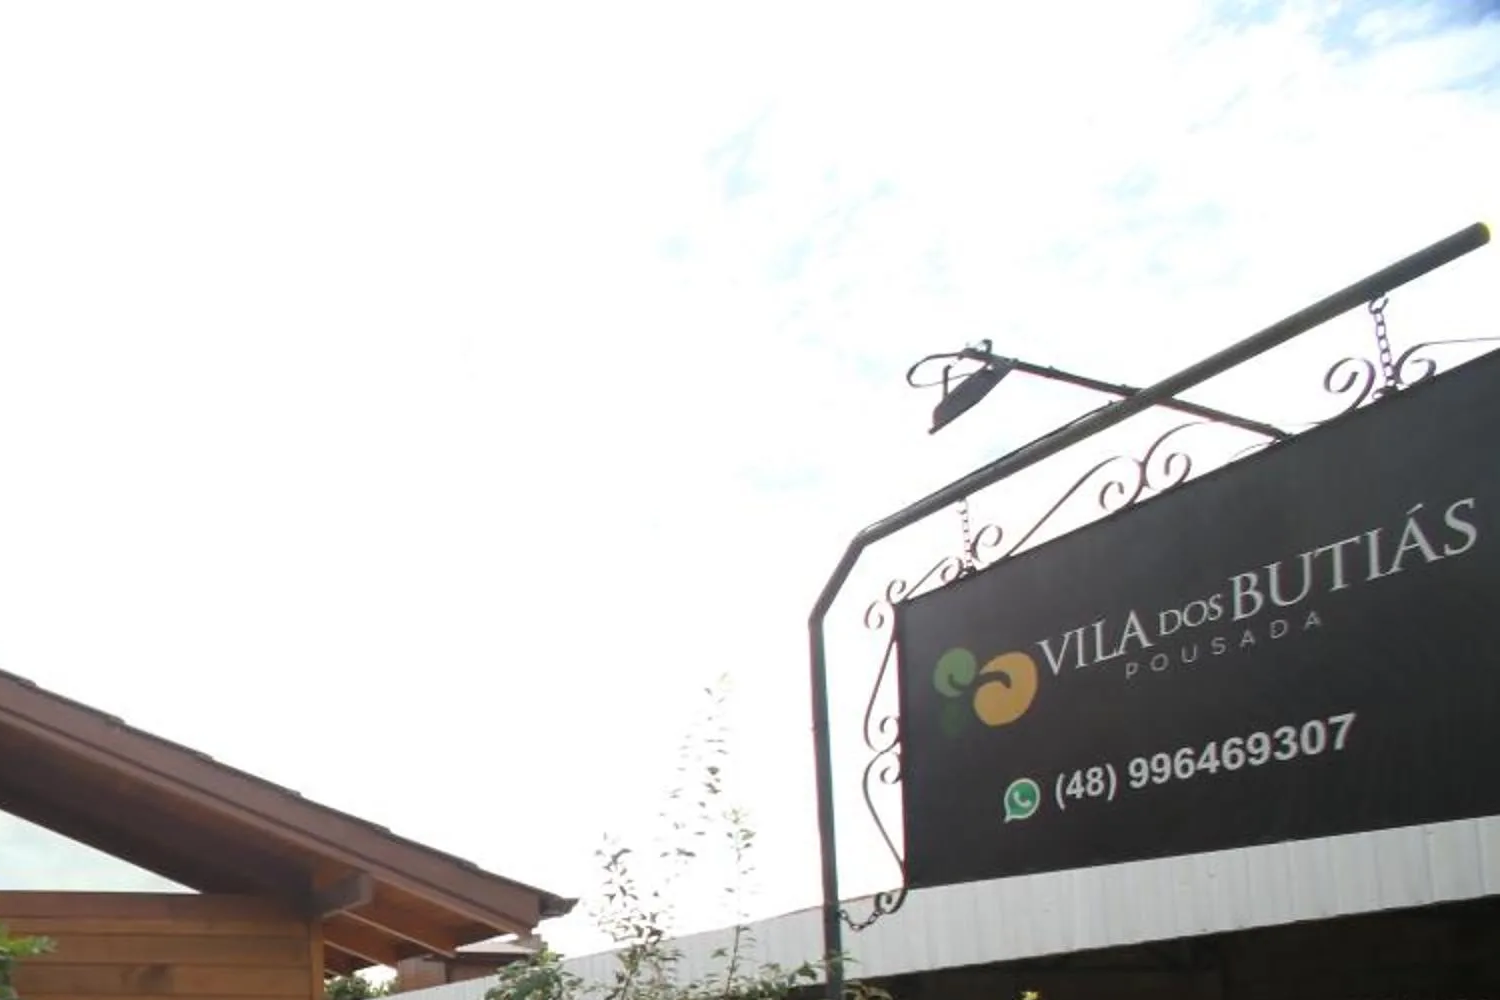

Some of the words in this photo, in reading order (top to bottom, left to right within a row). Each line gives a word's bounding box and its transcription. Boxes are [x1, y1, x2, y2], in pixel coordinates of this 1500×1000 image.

[1036, 609, 1152, 677] VILA
[1158, 593, 1224, 637] DOS
[1228, 497, 1478, 623] BUTIÁS
[1124, 610, 1323, 680] POUSADA
[1054, 763, 1118, 811] (48)
[1127, 712, 1356, 790] 996469307
